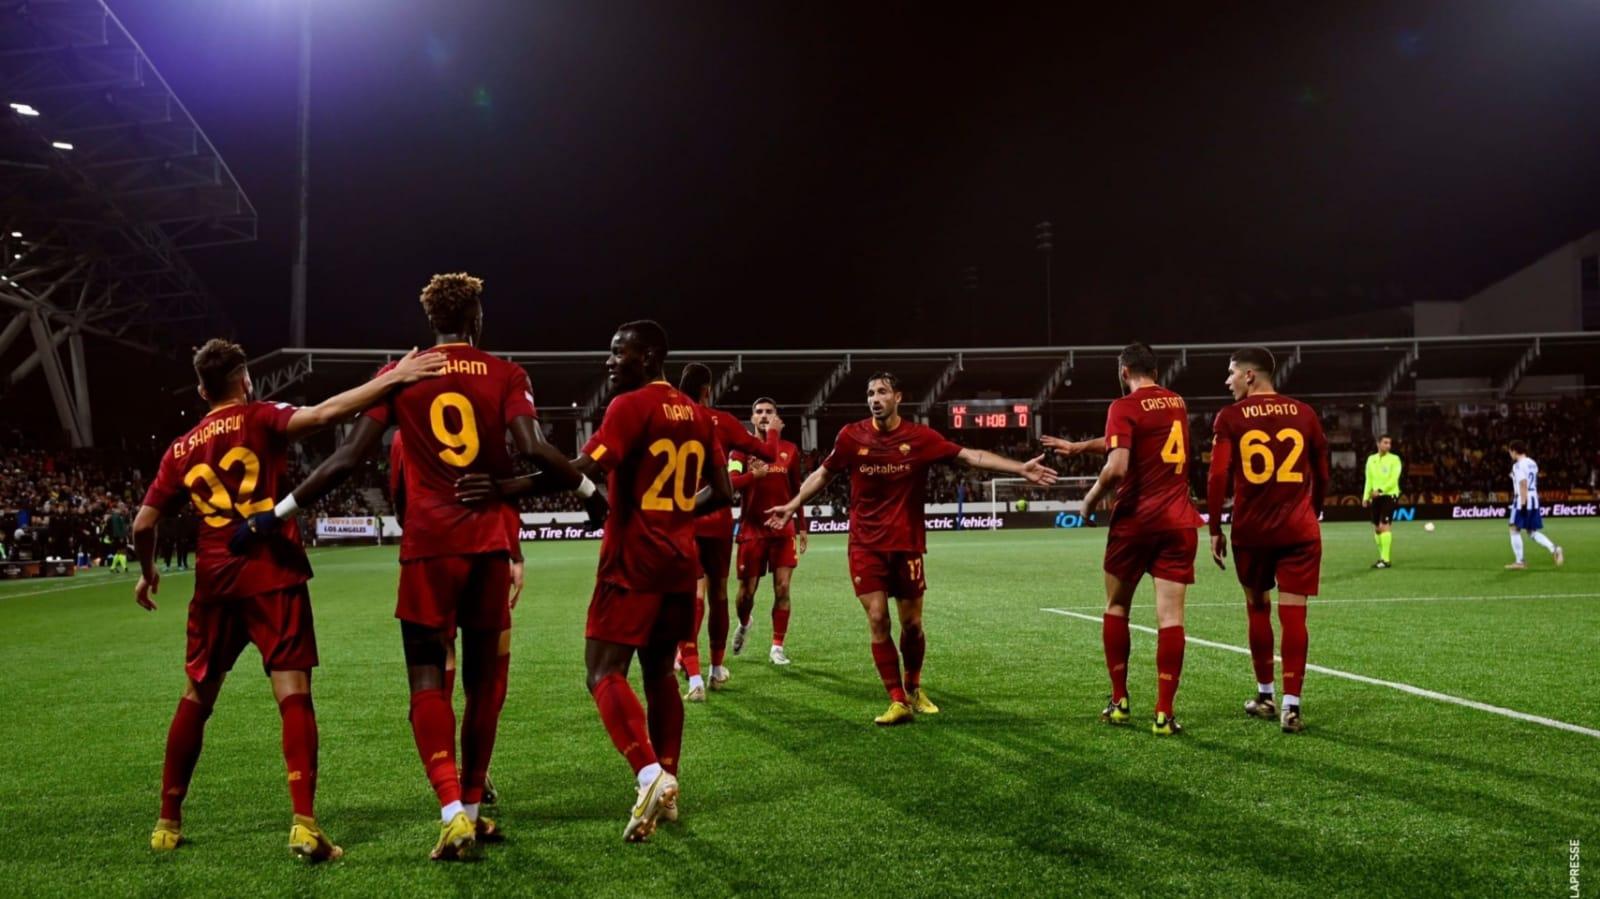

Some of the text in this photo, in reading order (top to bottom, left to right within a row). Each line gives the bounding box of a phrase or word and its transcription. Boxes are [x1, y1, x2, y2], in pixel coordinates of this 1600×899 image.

[442, 359, 488, 376] HAM
[1242, 402, 1298, 419] VOLPATO
[954, 414, 962, 428] 0
[974, 413, 1006, 428] 41:08
[1019, 413, 1028, 427] 0
[430, 391, 480, 468] 9
[173, 442, 187, 459] EL
[1160, 419, 1186, 474] 4
[1239, 427, 1305, 485] 62
[641, 438, 705, 512] 20
[859, 463, 911, 476] digitalbits
[1452, 505, 1507, 518] Exclusive
[1552, 503, 1597, 516] Electric
[518, 527, 536, 539] ive
[539, 527, 563, 539] Tire
[564, 526, 583, 539] for
[907, 558, 922, 580] 17
